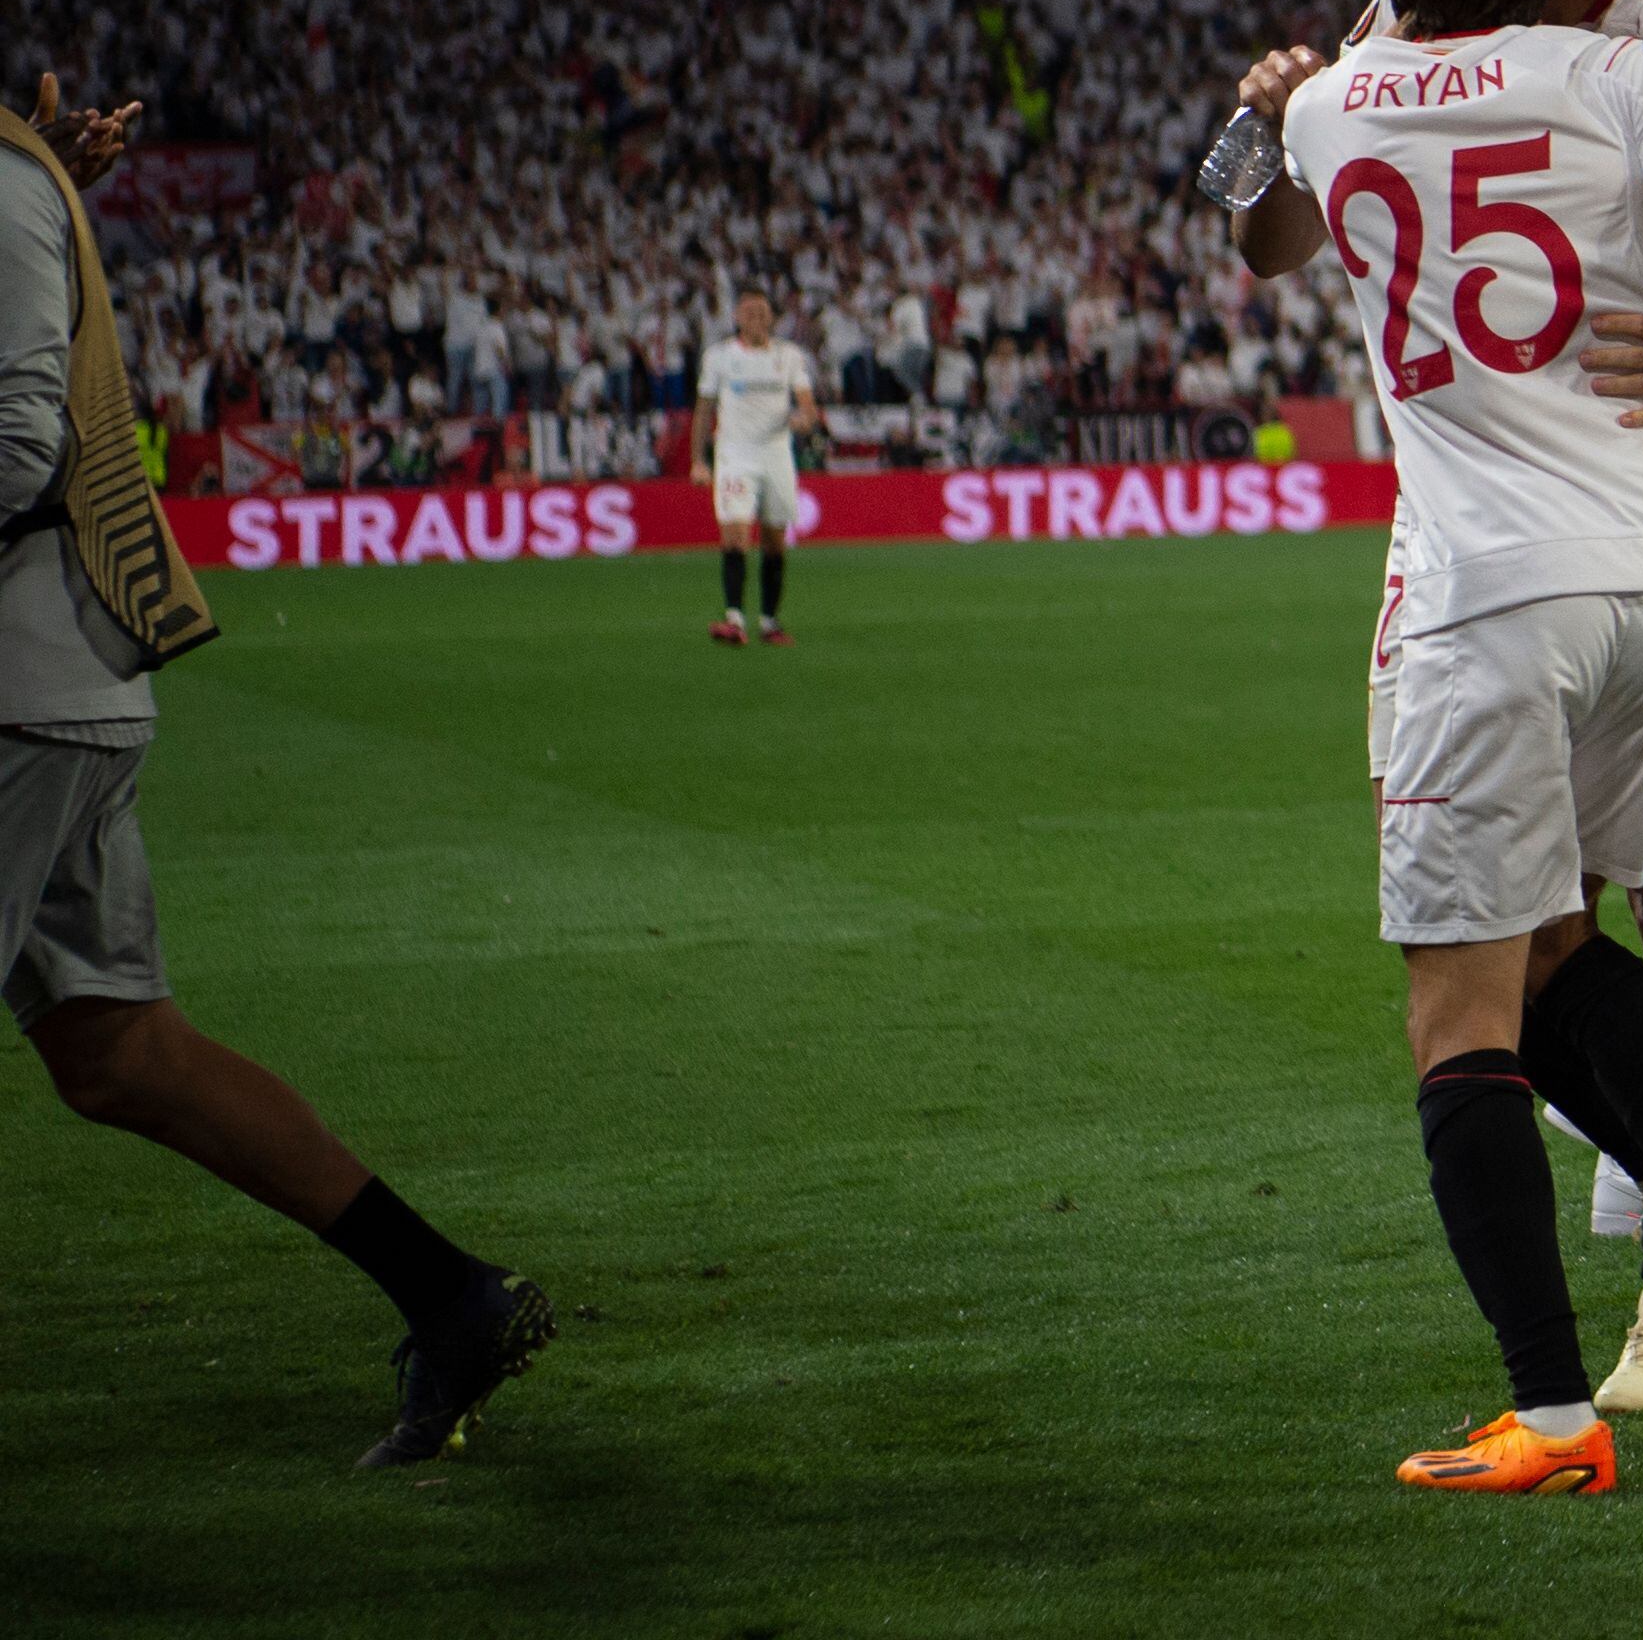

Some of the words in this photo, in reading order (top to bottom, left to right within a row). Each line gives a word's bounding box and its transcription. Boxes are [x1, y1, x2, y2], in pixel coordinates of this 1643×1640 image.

[1344, 59, 1505, 112] BRYAN
[1328, 130, 1585, 402] 25
[226, 485, 640, 571] STRAUSS
[941, 463, 1331, 544] STRAUSS
